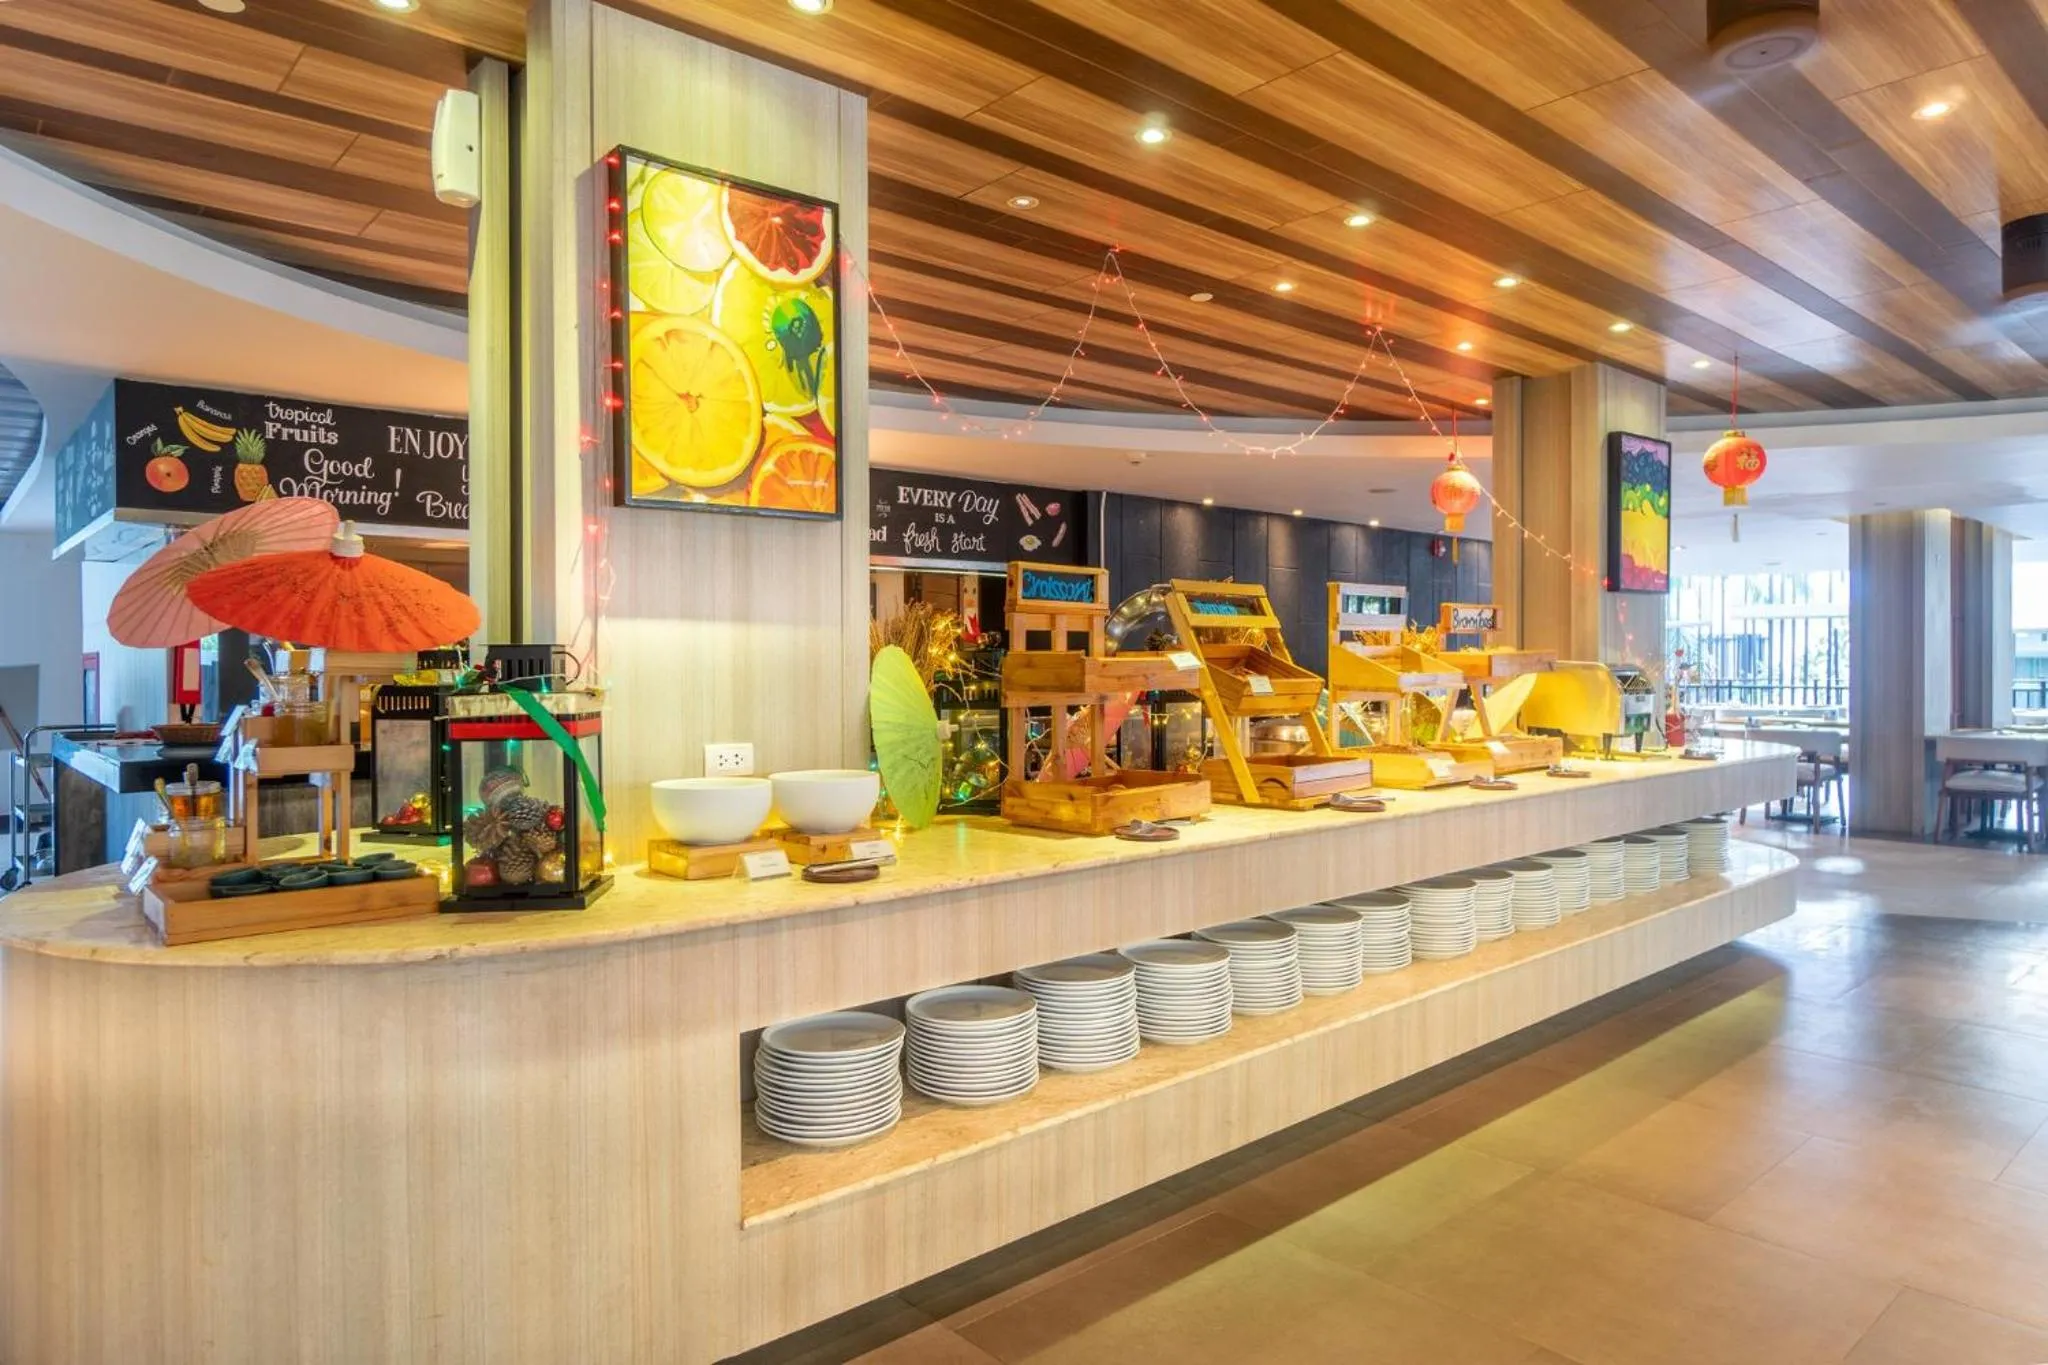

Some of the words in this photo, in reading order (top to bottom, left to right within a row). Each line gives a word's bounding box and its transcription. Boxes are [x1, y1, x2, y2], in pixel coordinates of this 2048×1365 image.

[265, 401, 336, 426] tropical
[265, 421, 339, 445] Fruits
[387, 425, 469, 460] ENJOY
[304, 448, 375, 486] Good
[897, 485, 957, 508] EVERY
[958, 490, 1000, 525] Day
[947, 514, 956, 524] A
[902, 522, 942, 555] fresh
[951, 533, 987, 554] start
